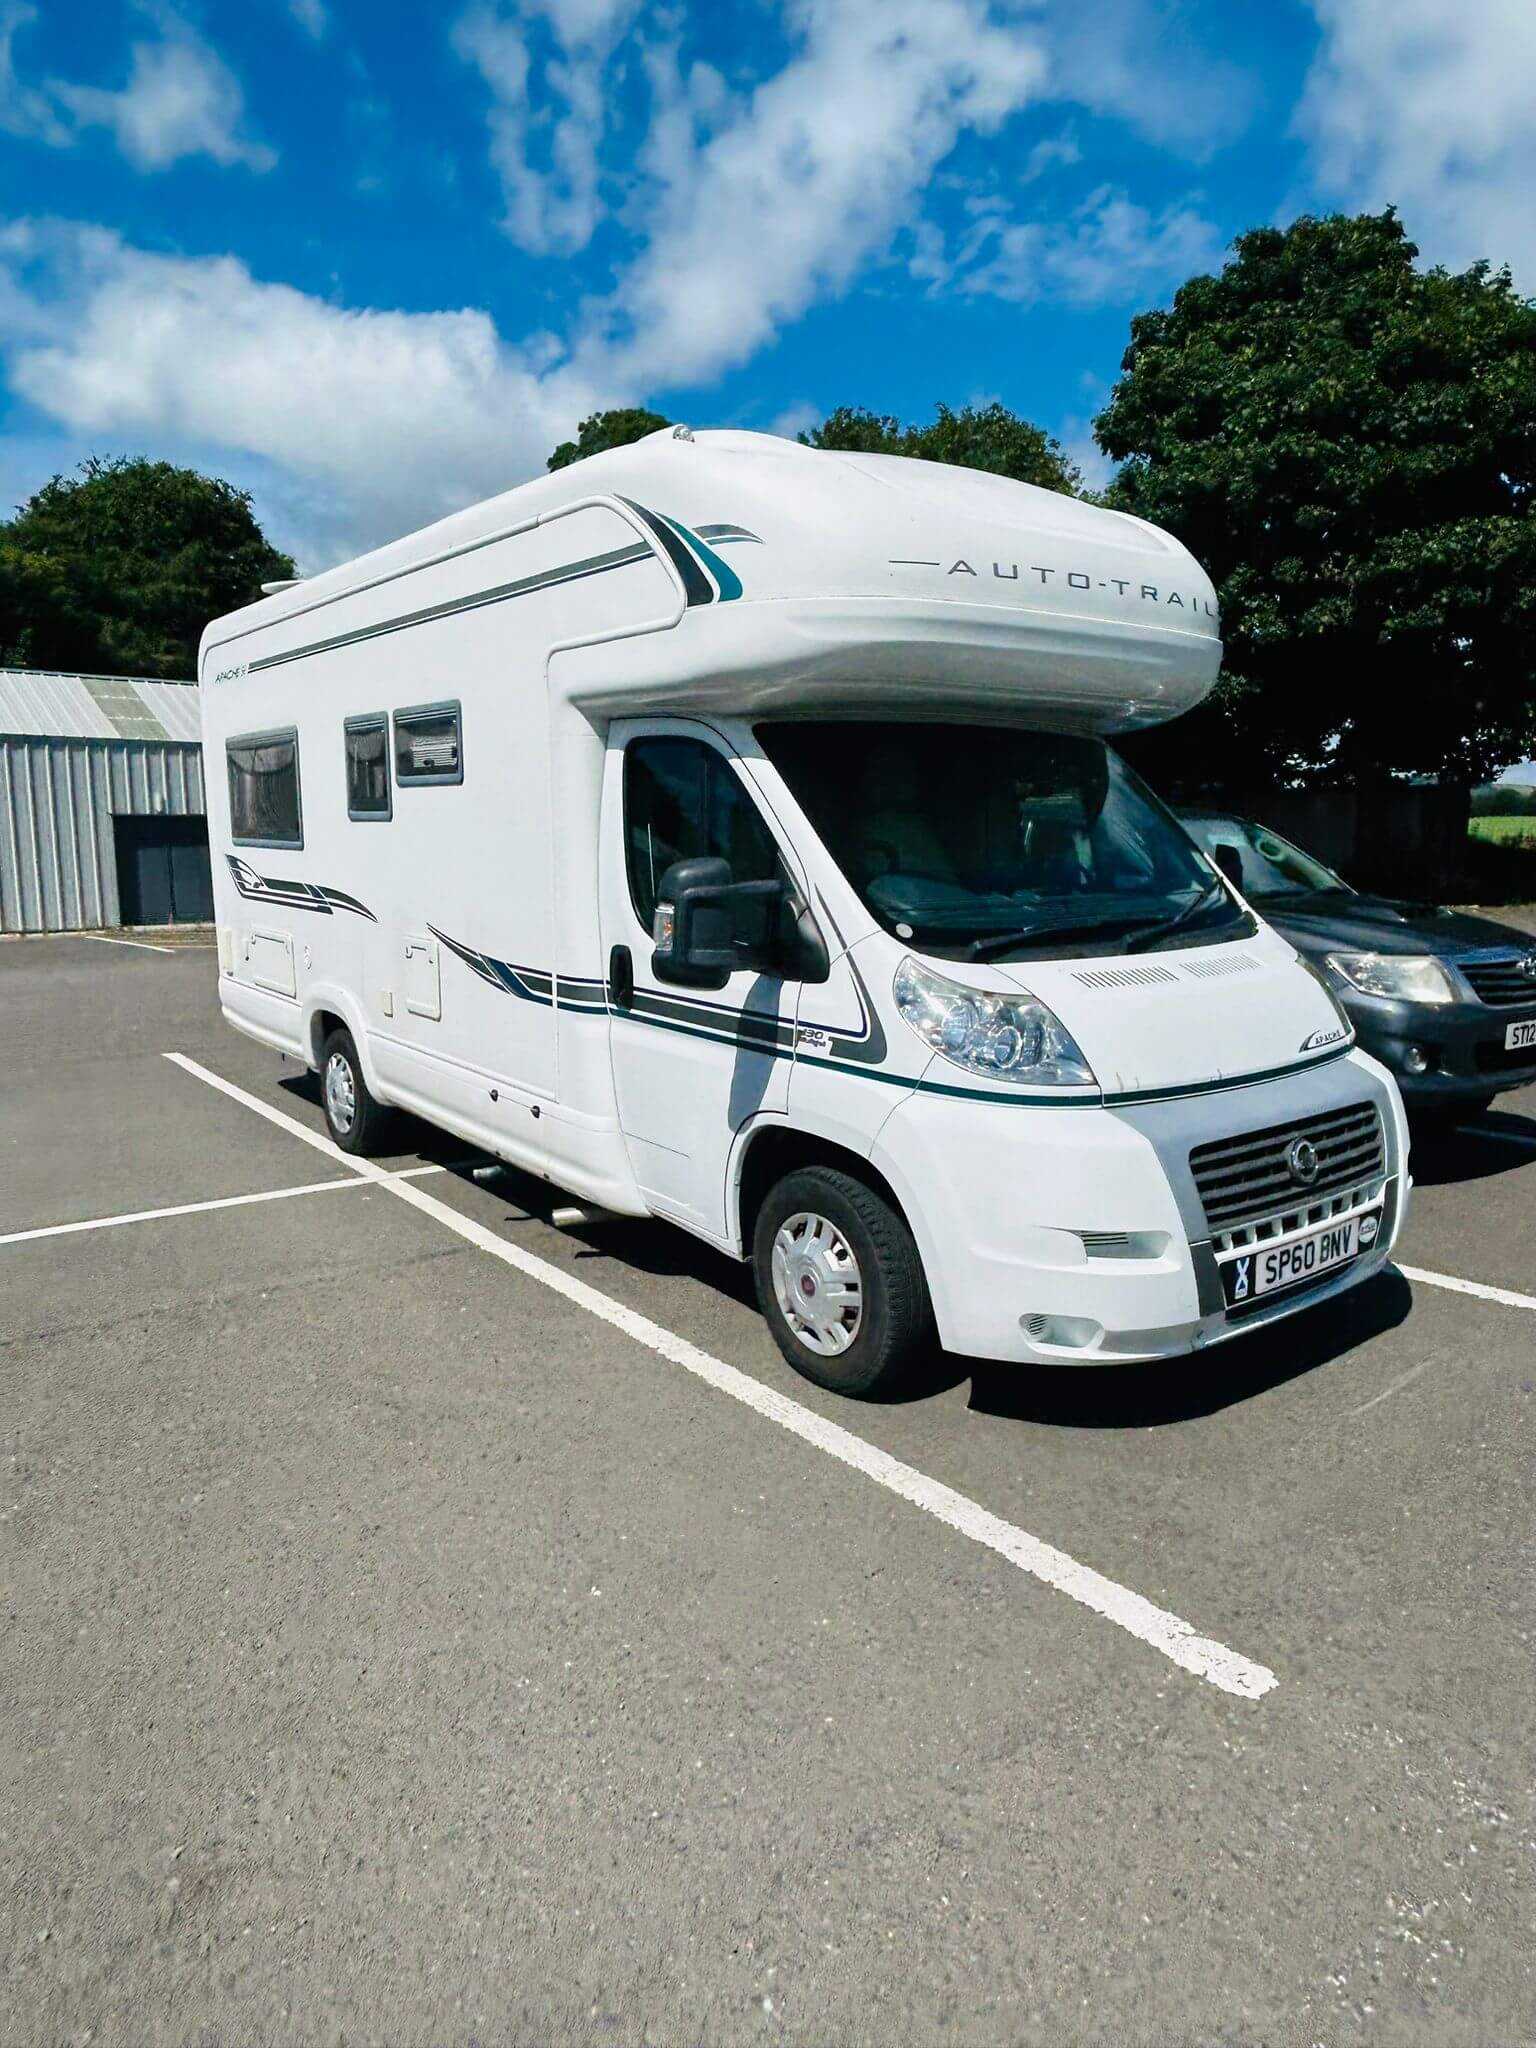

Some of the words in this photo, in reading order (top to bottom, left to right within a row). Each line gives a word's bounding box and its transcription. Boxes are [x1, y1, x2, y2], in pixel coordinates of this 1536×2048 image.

[947, 559, 1217, 617] AUTO-TRAIL
[1265, 1240, 1315, 1284] SP60
[1320, 1223, 1352, 1264] BNV
